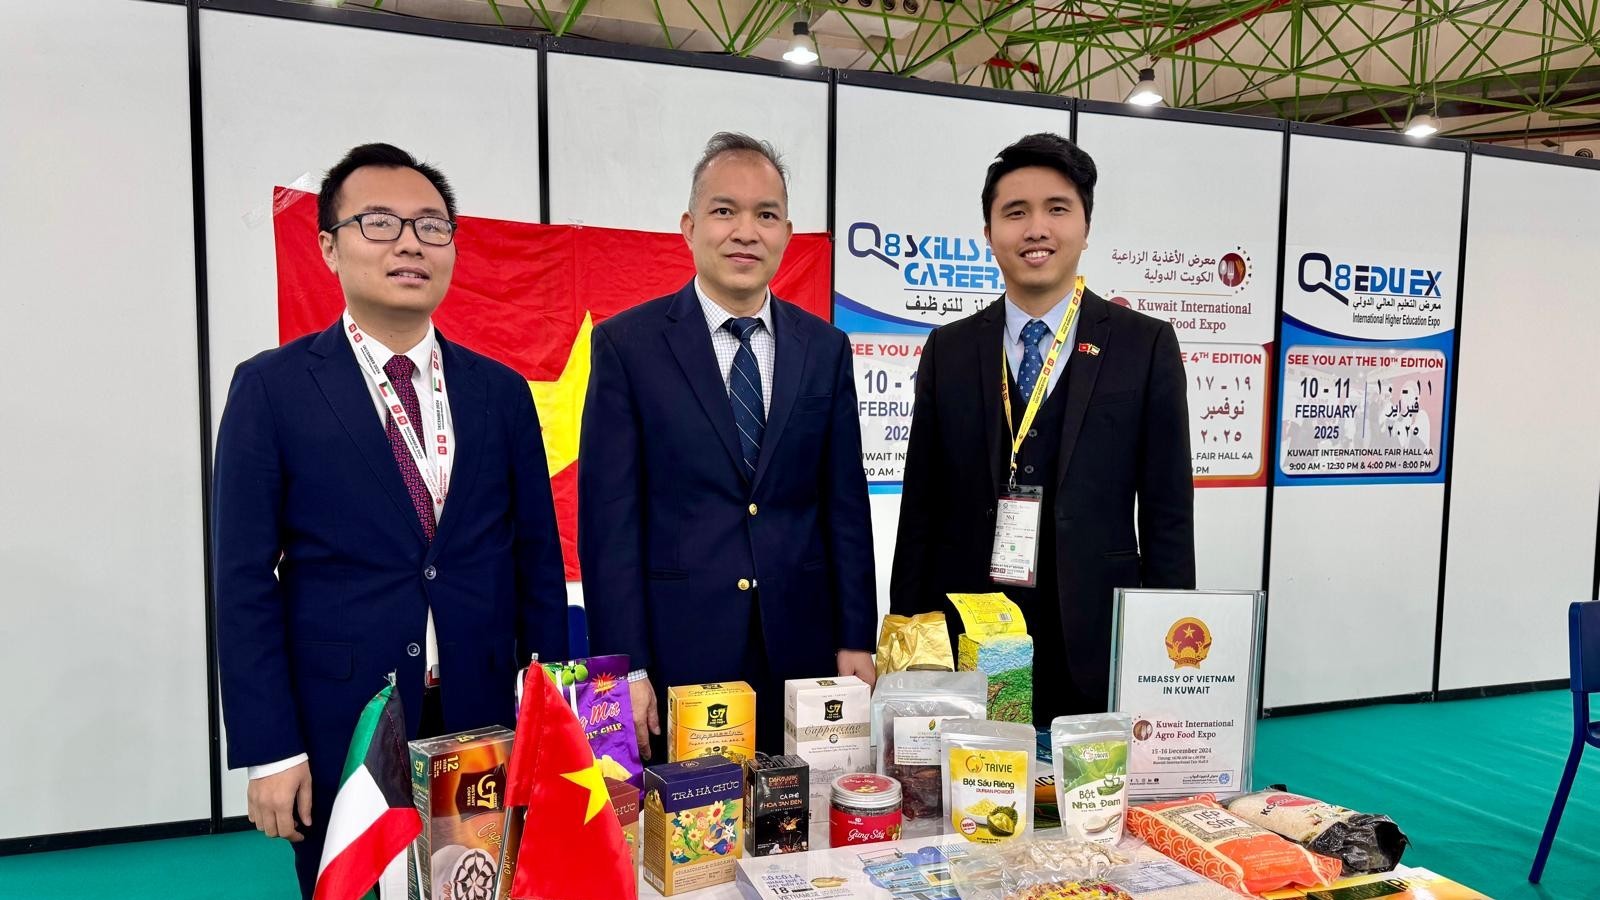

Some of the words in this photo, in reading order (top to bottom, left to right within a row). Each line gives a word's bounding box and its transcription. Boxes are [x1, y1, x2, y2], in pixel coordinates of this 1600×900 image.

[1112, 249, 1148, 264] الزراعية
[1152, 250, 1184, 266] الأغذية
[1188, 254, 1216, 267] معرض
[904, 262, 1004, 289] CAREER
[1144, 269, 1176, 284] الدولية
[1180, 272, 1214, 285] الكويت
[1137, 298, 1178, 312] Kuwait
[1181, 300, 1252, 314] International
[1397, 299, 1416, 311] التعليم
[1418, 302, 1442, 312] معرض
[1170, 318, 1196, 330] Food
[1199, 318, 1226, 333] Expo
[1352, 313, 1384, 324] International
[1385, 314, 1402, 327] Higher
[1402, 315, 1427, 326] Education
[1428, 316, 1440, 328] Expo
[878, 344, 909, 356] YOU
[914, 345, 923, 356] A
[1191, 352, 1208, 363] 4TH
[1212, 352, 1262, 364] EDITION
[1288, 354, 1309, 364] SEE
[1312, 355, 1335, 366] YOU
[1338, 356, 1354, 366] AT
[1356, 356, 1376, 366] THE
[1400, 358, 1443, 368] EDITION
[864, 370, 888, 394] 10
[1300, 377, 1318, 398] 10
[1335, 377, 1350, 398] 11
[1200, 397, 1244, 420] نوفمبر
[1295, 404, 1357, 418] FEBRUARY
[1386, 397, 1419, 418] فبراير
[884, 426, 908, 440] 202
[1314, 426, 1339, 439] 2025
[1196, 452, 1216, 460] FAIR
[1218, 452, 1240, 460] HALL
[878, 468, 894, 476] AM
[826, 704, 841, 713] G7
[601, 723, 622, 733] CHIP
[804, 724, 860, 737] Cappuccino
[1155, 732, 1175, 741] Agro
[1198, 731, 1216, 740] Expo
[448, 754, 459, 772] 12
[985, 763, 1012, 773] TRIVIE
[963, 778, 976, 788] Bột
[477, 774, 496, 809] G7
[1079, 790, 1095, 801] Bột
[1100, 799, 1120, 808] Đam
[771, 887, 789, 895] 18
